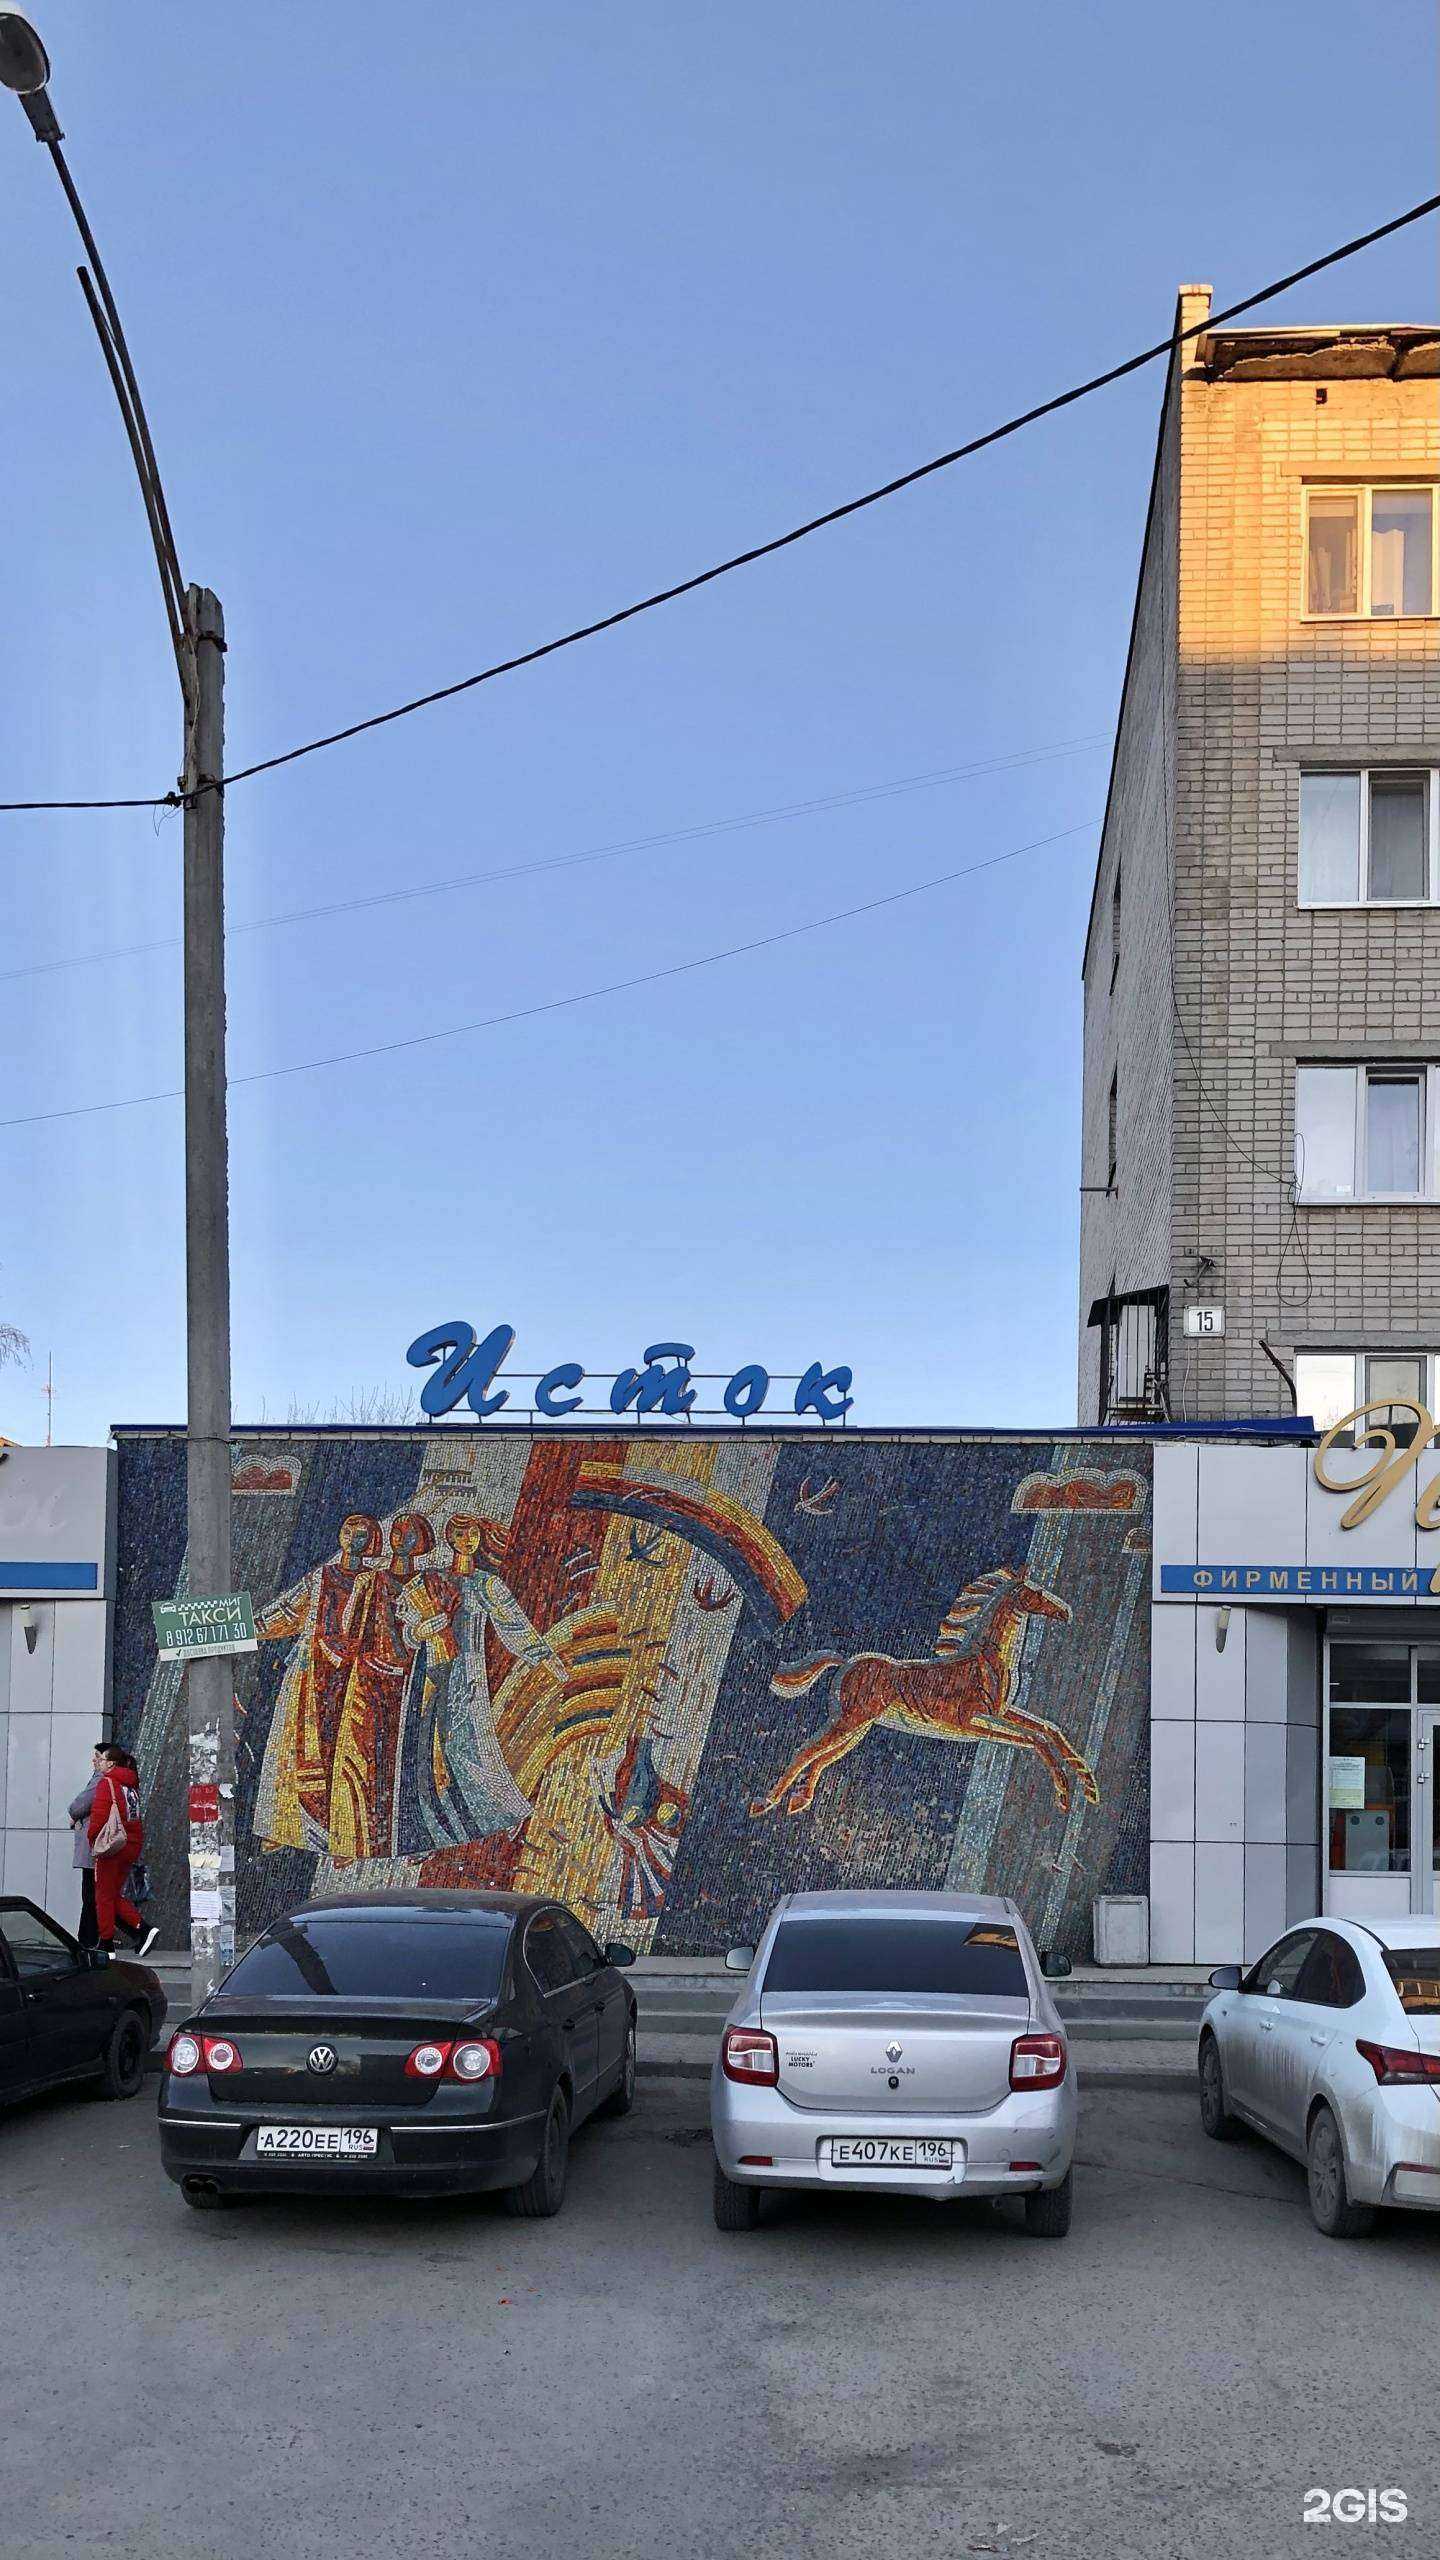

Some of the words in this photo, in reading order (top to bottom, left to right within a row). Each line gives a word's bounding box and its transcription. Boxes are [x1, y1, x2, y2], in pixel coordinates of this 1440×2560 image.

[1197, 1311, 1214, 1332] 15
[406, 1320, 855, 1420] Исток
[1193, 1569, 1418, 1591] ФИРМЕННЫЙ
[219, 1596, 243, 1607] МИГ
[178, 1606, 242, 1627] ТАКСИ
[175, 1628, 195, 1646] 912
[232, 1622, 247, 1639] 30
[344, 2130, 373, 2144] 196
[918, 2142, 946, 2157] 196
